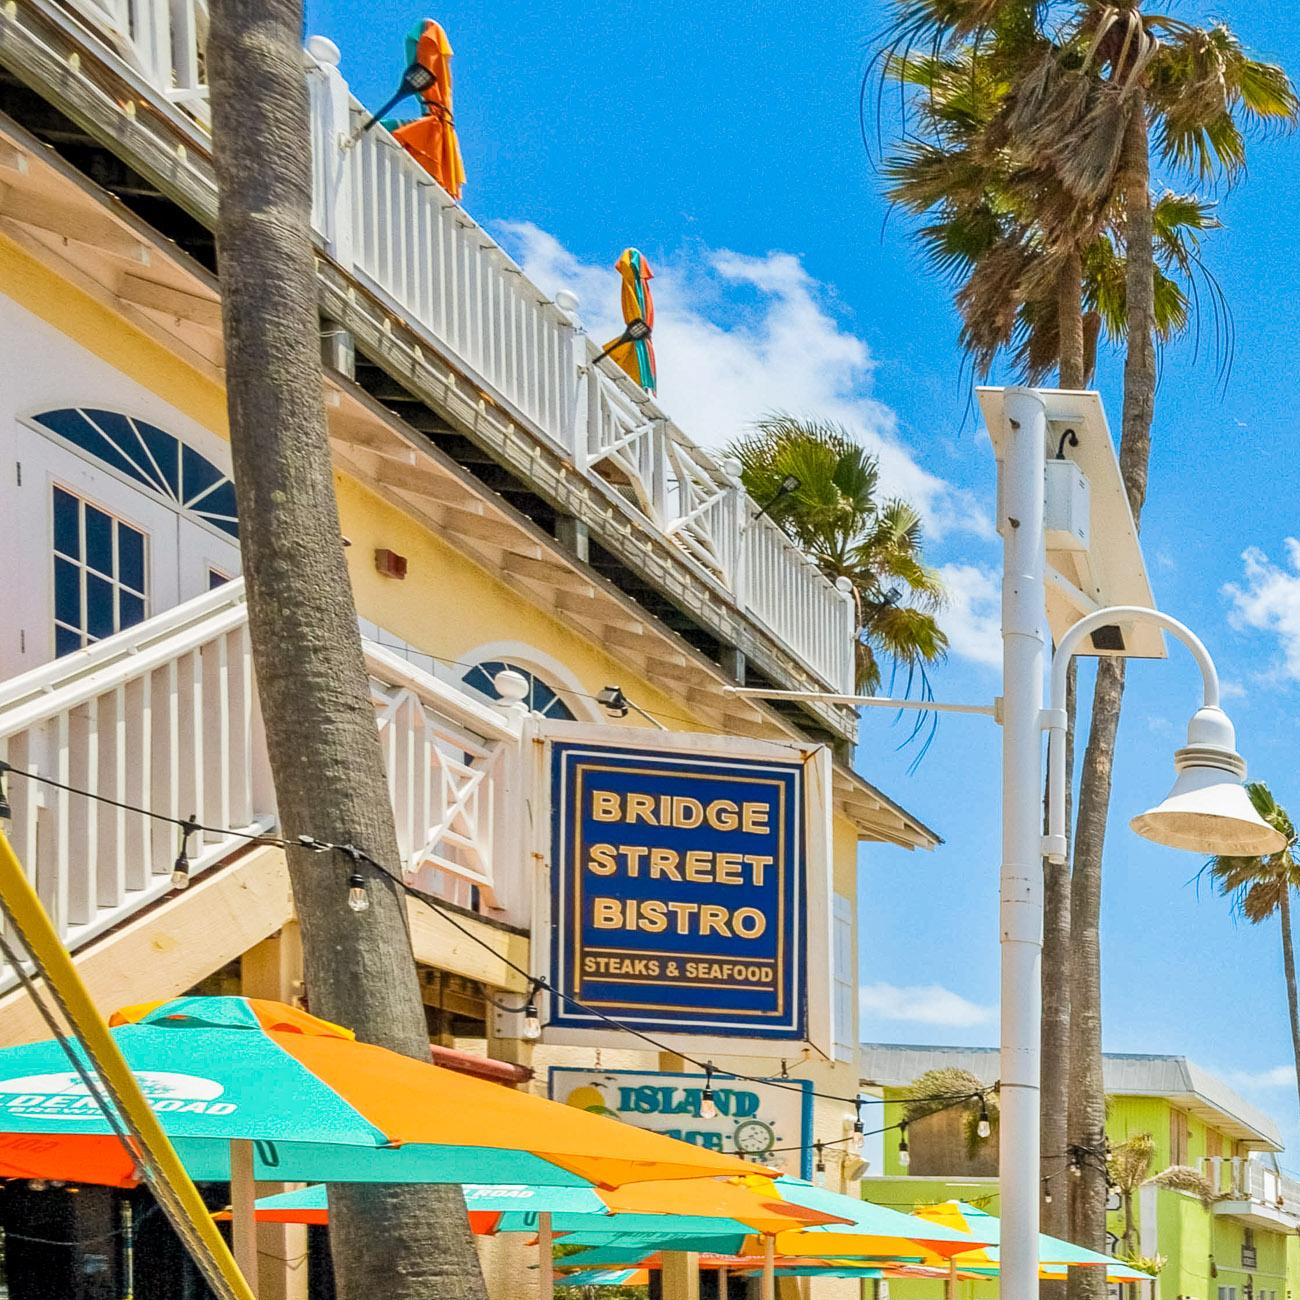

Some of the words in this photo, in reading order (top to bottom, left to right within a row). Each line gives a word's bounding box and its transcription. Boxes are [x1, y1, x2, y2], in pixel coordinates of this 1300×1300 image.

[591, 789, 771, 835] BRIDGE
[587, 843, 774, 887] STREET
[593, 897, 767, 940] BISTRO
[583, 956, 661, 977] STEAKS
[665, 961, 680, 977] &
[685, 962, 774, 983] SEAFOOD
[146, 1099, 239, 1116] OAD
[617, 1085, 761, 1118] ISLAND
